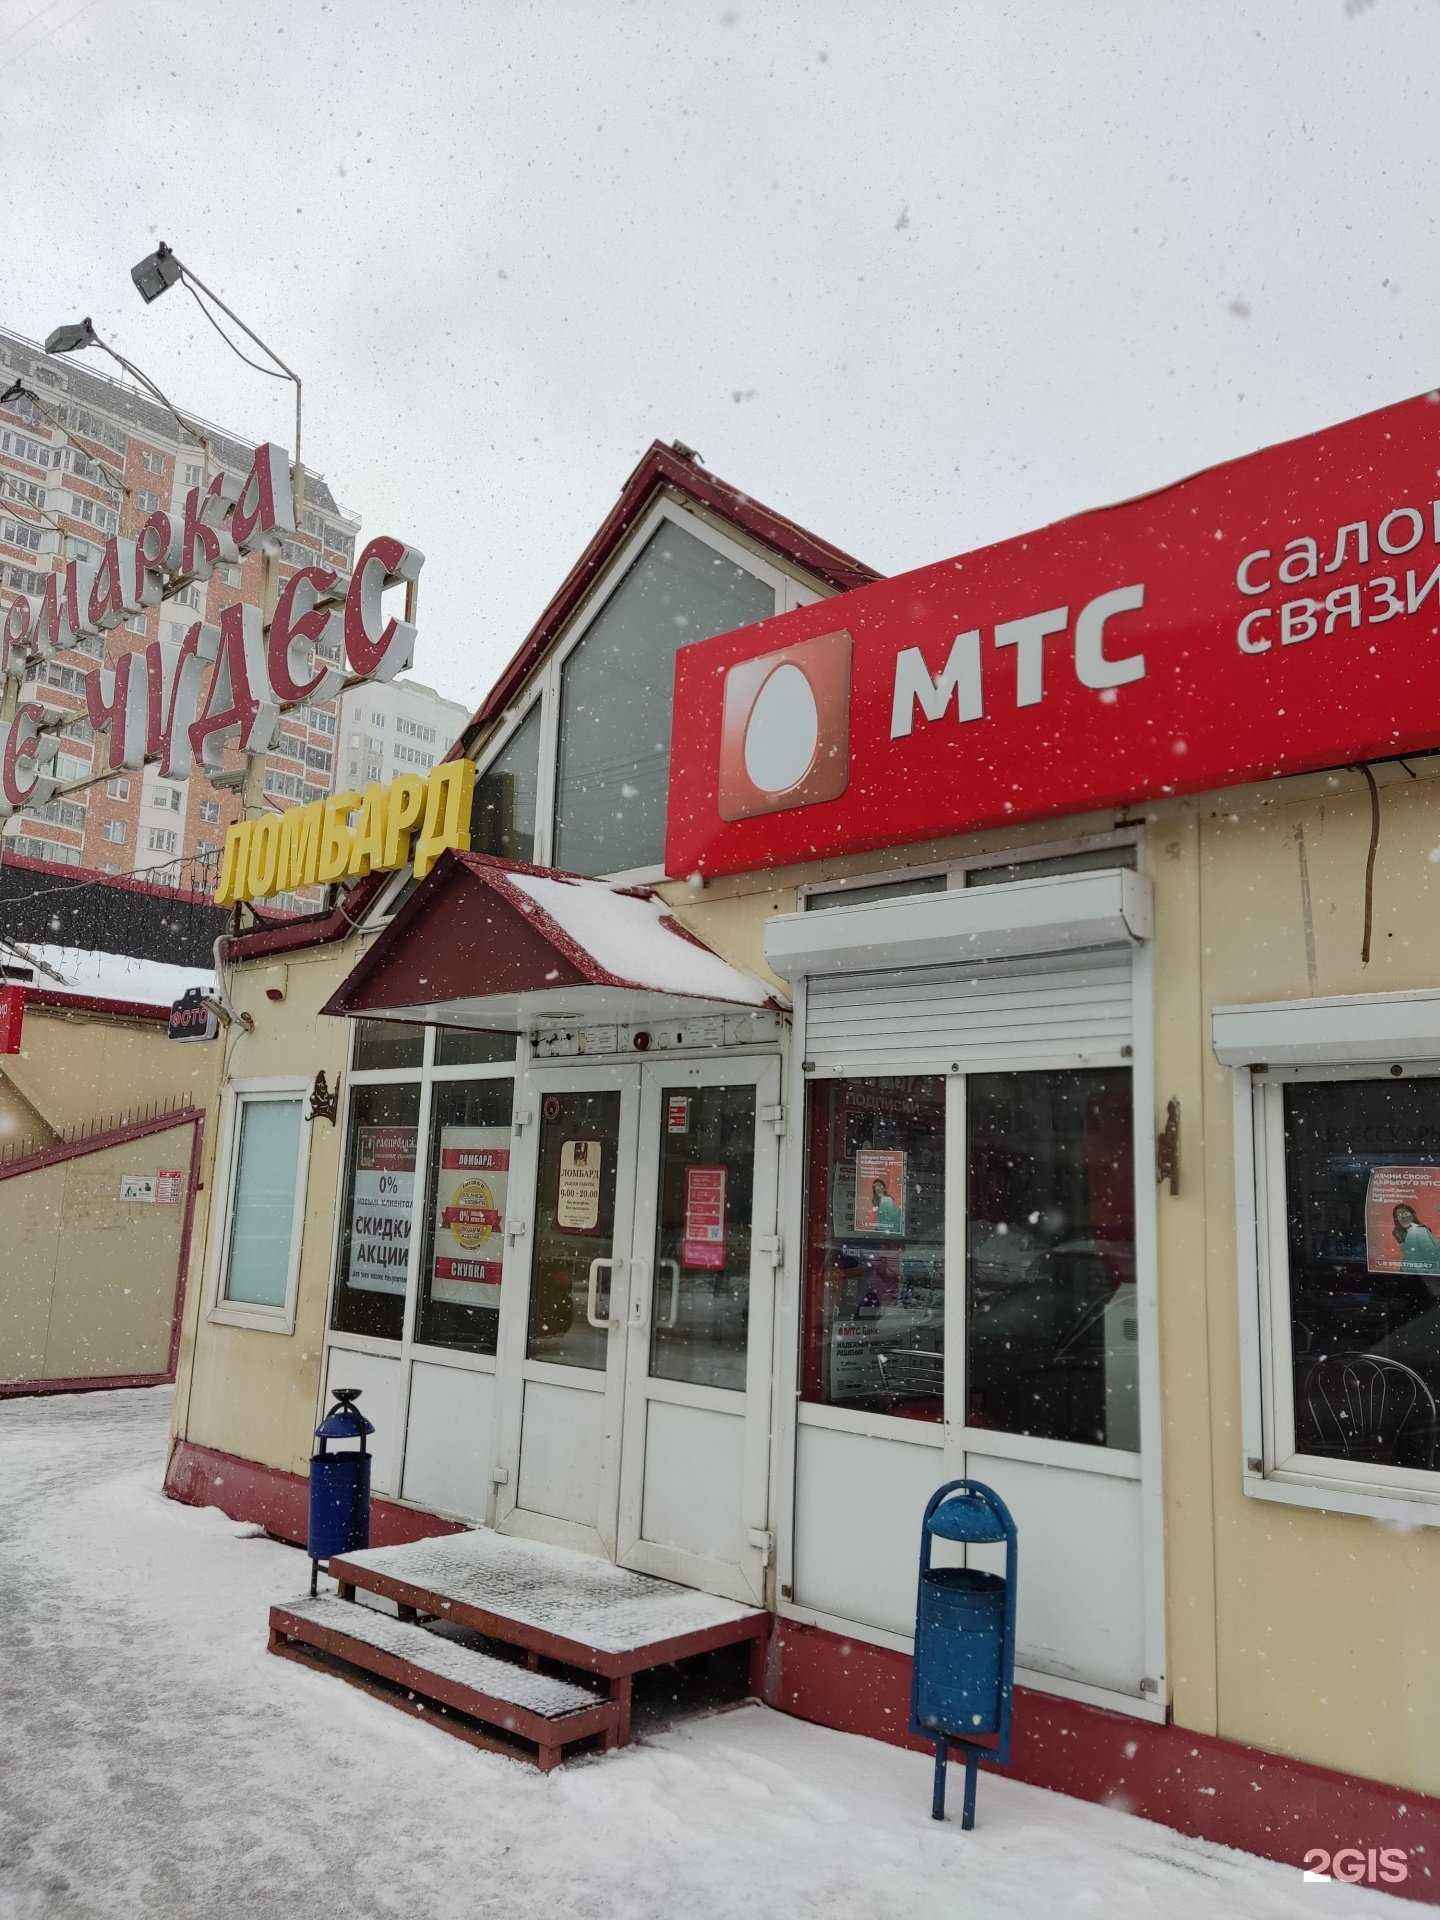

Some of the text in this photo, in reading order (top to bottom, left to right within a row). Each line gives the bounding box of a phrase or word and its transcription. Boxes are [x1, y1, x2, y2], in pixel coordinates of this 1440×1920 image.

[1236, 500, 1440, 595] сало
[1237, 562, 1440, 654] связи
[86, 536, 420, 780] ЧУДЕС
[890, 583, 1145, 740] МТС
[214, 758, 475, 906] ЛОМБАРД
[379, 1175, 398, 1194] 0%
[561, 1169, 599, 1179] ЛОМБАРД
[357, 1243, 408, 1268] АКЦИИ
[451, 1262, 486, 1279] СКУПКА
